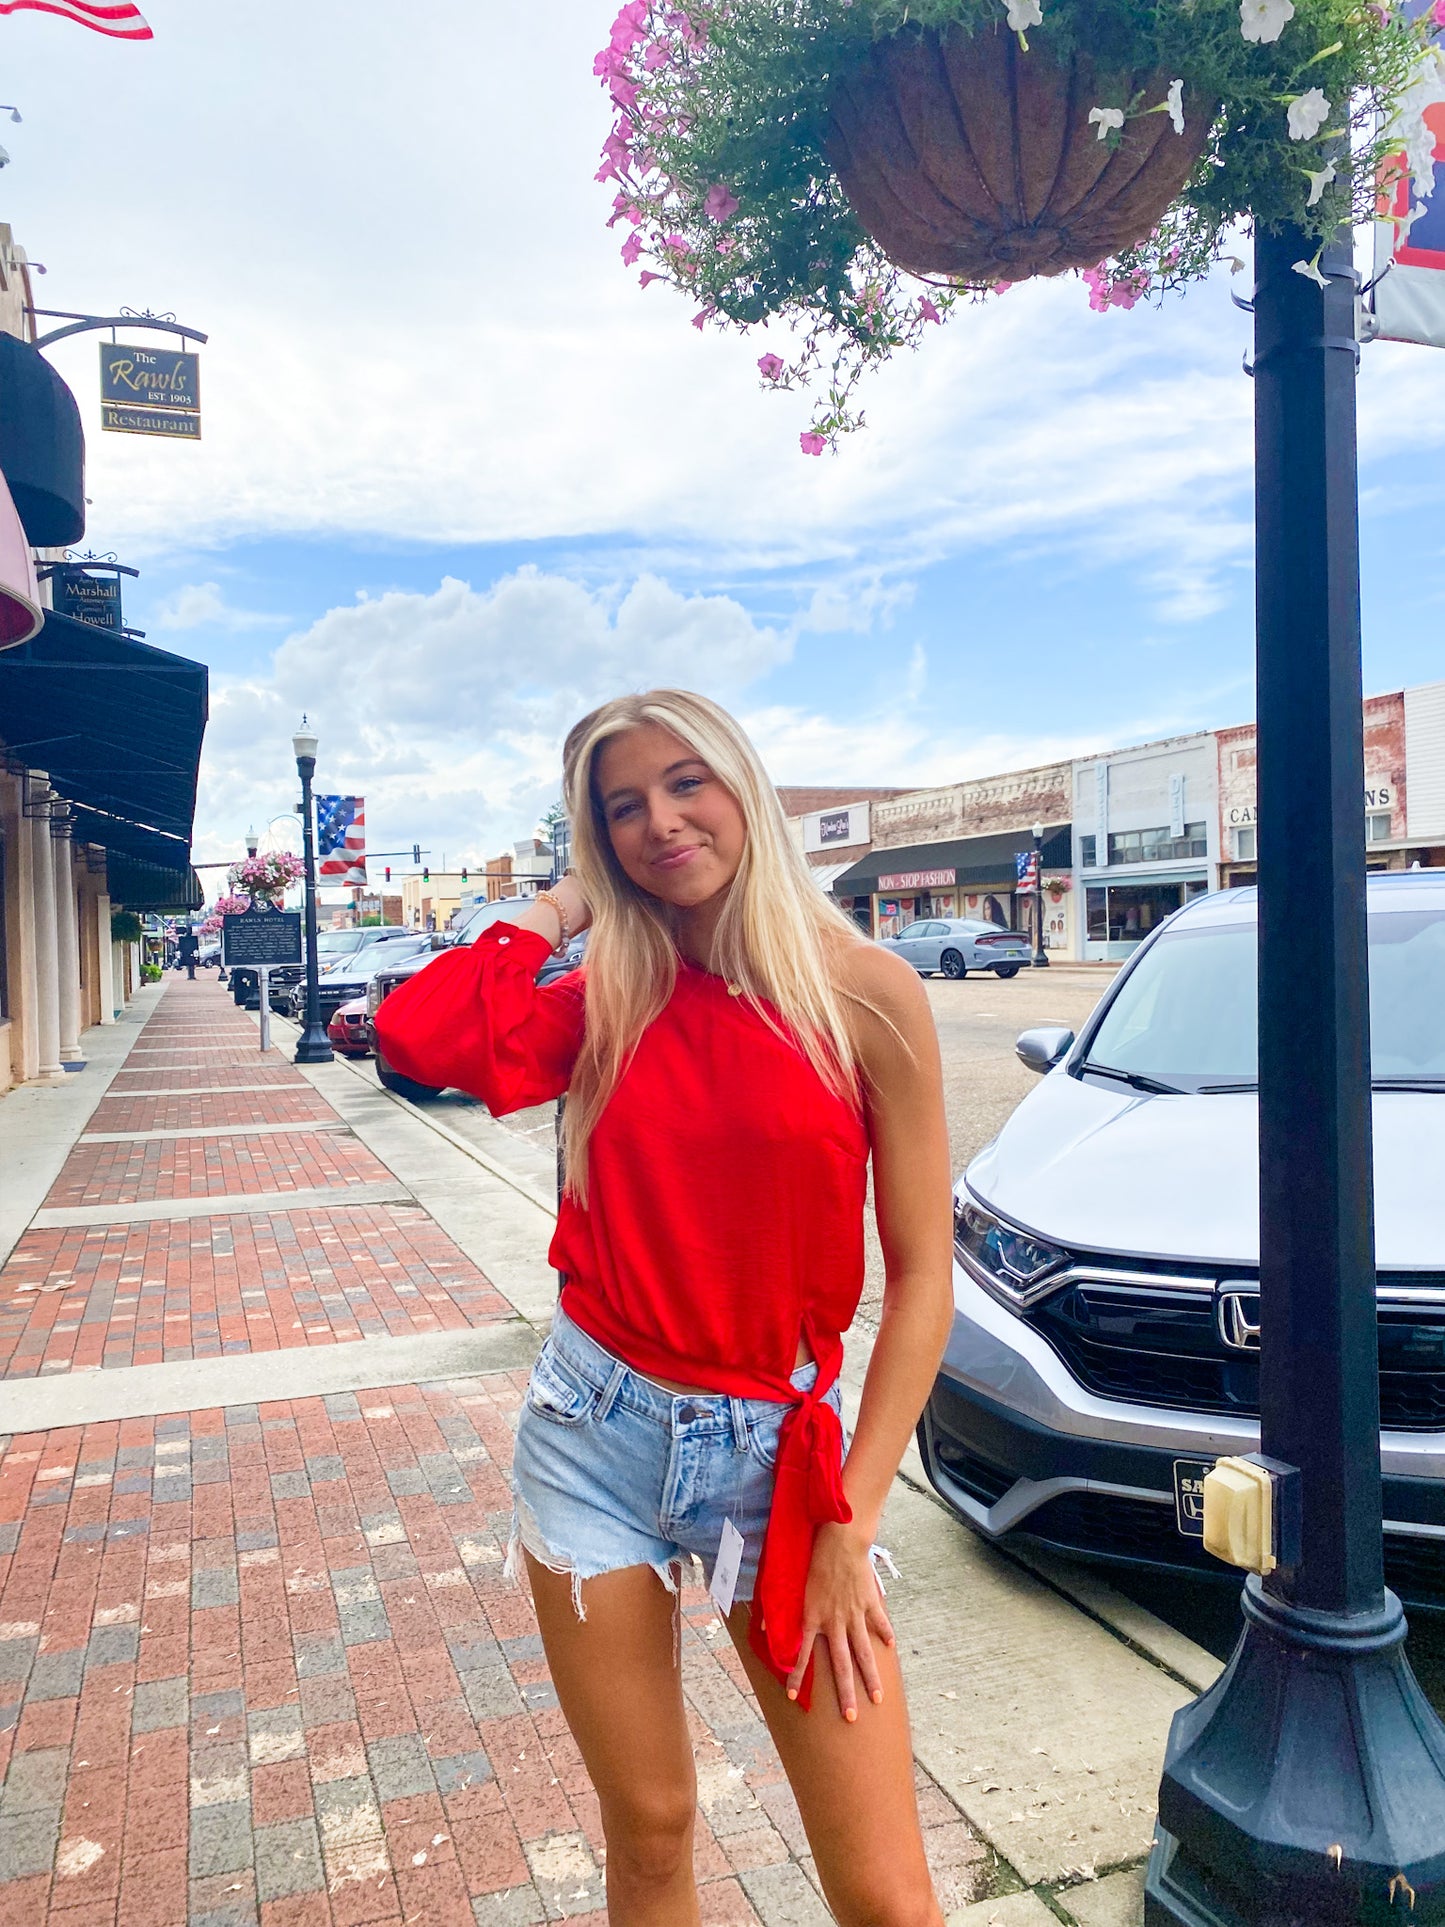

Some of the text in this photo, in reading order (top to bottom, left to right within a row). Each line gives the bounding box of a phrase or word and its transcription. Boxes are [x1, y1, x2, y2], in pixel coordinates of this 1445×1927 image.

[133, 352, 157, 364] The
[109, 360, 187, 391] Rawls
[108, 411, 195, 432] Restaurant
[65, 583, 117, 597] Marshall
[73, 611, 113, 625] Howell
[878, 876, 894, 890] NON
[900, 873, 920, 888] STOP
[921, 869, 956, 886] FASHION
[1181, 1478, 1204, 1493] SA
